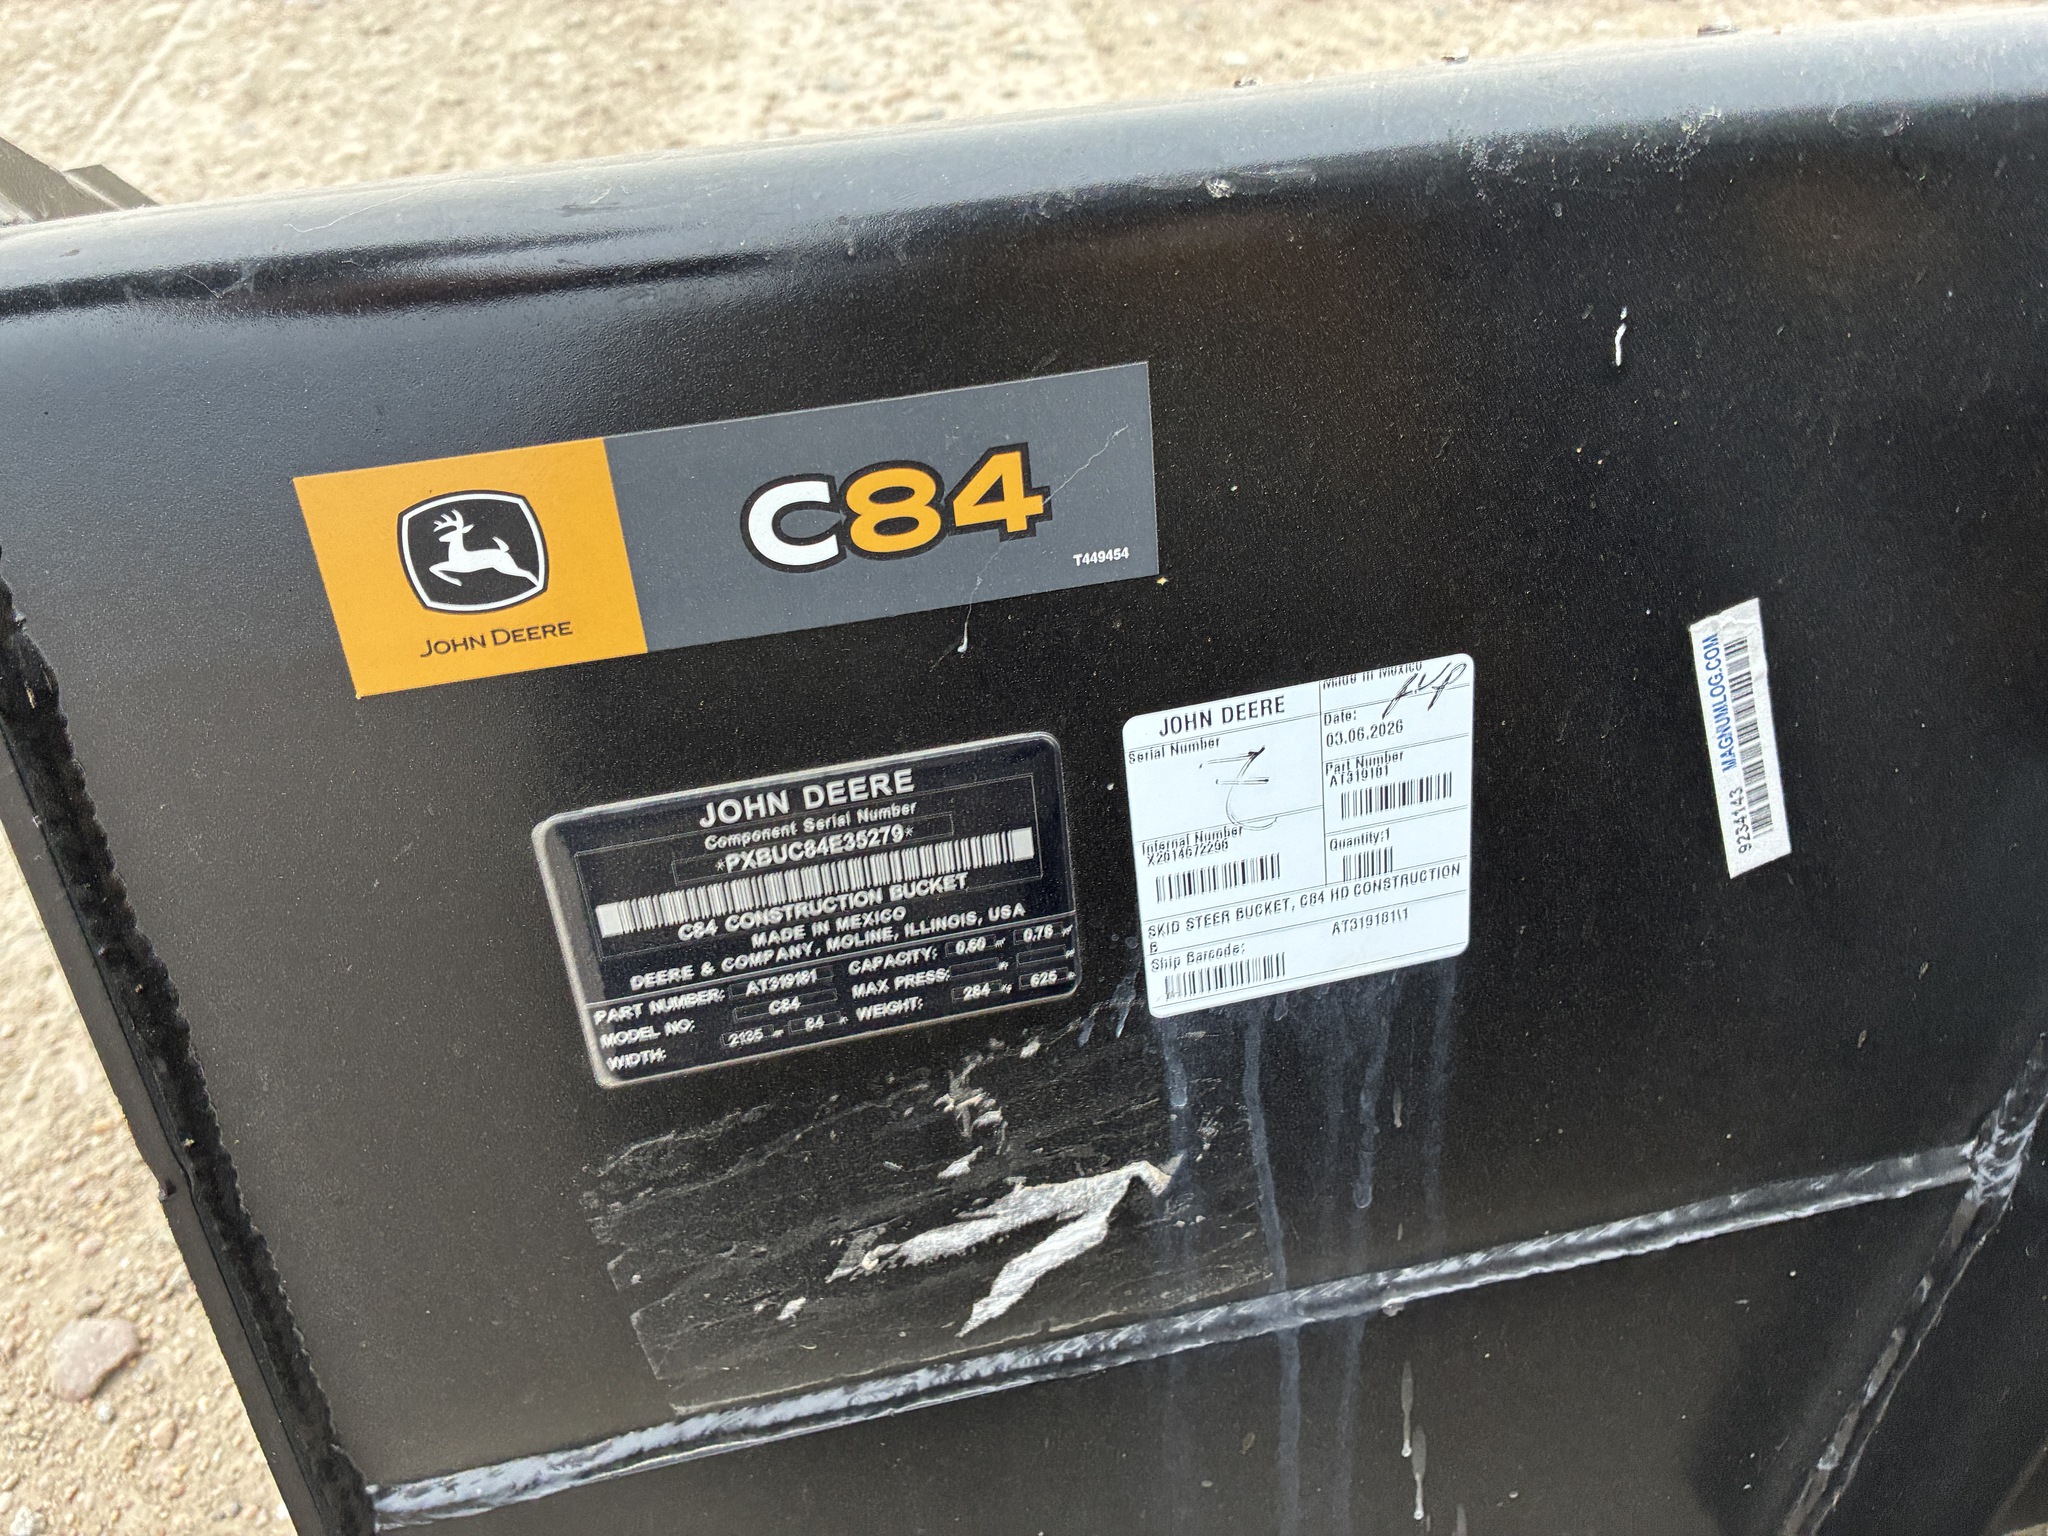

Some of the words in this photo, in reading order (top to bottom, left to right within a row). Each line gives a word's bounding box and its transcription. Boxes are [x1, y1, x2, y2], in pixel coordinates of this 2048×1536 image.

[744, 444, 1049, 570] C84
[1073, 546, 1130, 567] T449454
[419, 632, 487, 660] JOHN
[490, 621, 574, 649] DEERE
[1159, 709, 1213, 737] JOHN
[1222, 695, 1286, 724] DEERE
[1323, 709, 1357, 727] Date:
[1702, 633, 1737, 773] MAGNUMLOG.COM
[1128, 744, 1165, 764] Serial
[1170, 737, 1220, 757] Number
[1326, 719, 1404, 747] 03.06.2026
[1325, 757, 1350, 776] Part
[1355, 750, 1405, 769] Number
[699, 789, 791, 828] JOHN
[802, 768, 916, 810] DEERE
[704, 820, 798, 851] Component
[803, 810, 851, 833] Serial
[857, 801, 918, 823] Number
[1729, 787, 1752, 854] 9234143
[1142, 832, 1190, 856] Internal
[1194, 825, 1243, 843] Number
[678, 918, 719, 943] C84
[724, 888, 883, 933] CONSTRUCTION
[889, 871, 969, 904] BUCKET
[1148, 921, 1181, 940] SKID
[1186, 910, 1231, 932] STEER
[1236, 897, 1296, 921] BUCKET,
[1329, 885, 1350, 903] HD
[1353, 862, 1461, 897] CONSTRUCTION
[630, 965, 695, 991] DEERE
[701, 961, 716, 977] &
[721, 942, 821, 974] COMPANY,
[826, 925, 899, 955] MOLINE,
[904, 911, 984, 940] ILLINOIS,
[987, 902, 1026, 922] USA
[752, 926, 809, 949] MADE
[812, 920, 832, 937] IN
[835, 906, 907, 934] MEXICO
[848, 946, 938, 976] CAPACITY:
[1151, 955, 1182, 973] Ship
[1186, 942, 1246, 966] Barcode:
[851, 979, 890, 999] MAX
[894, 968, 951, 991] PRESS:
[593, 1002, 644, 1026] PART
[649, 988, 726, 1016] NUMBER:
[599, 1025, 661, 1049] MODEL
[768, 995, 801, 1016] C84
[855, 996, 924, 1022] WEIGHT:
[606, 1047, 668, 1072] WIDTH:
